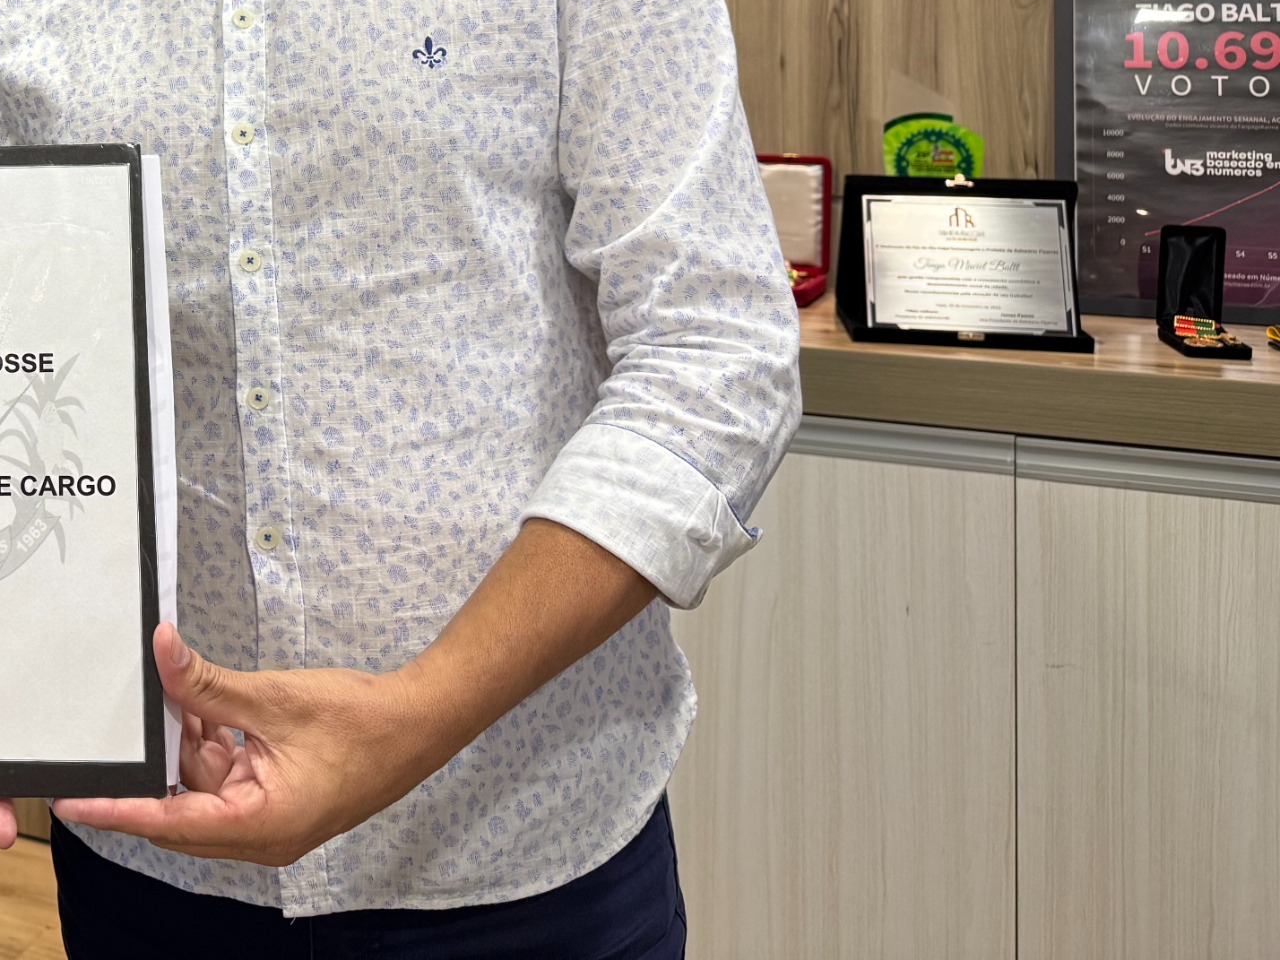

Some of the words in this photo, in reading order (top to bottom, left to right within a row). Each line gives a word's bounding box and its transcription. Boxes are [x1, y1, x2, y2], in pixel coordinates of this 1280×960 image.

[1134, 74, 1270, 97] VOTO
[1127, 113, 1165, 123] EVOLUÇÃO
[1178, 115, 1232, 123] ENGAJAMENTO
[1233, 116, 1270, 124] SEMANAL,
[1103, 128, 1124, 137] 10000
[1106, 150, 1125, 159] 8000
[1206, 150, 1272, 162] marketing
[1206, 159, 1263, 169] baseado
[1106, 172, 1125, 180] 6000
[1107, 193, 1125, 202] 4000
[1107, 215, 1125, 224] 2000
[1235, 249, 1245, 258] S4
[20, 475, 116, 497] CARGO
[16, 517, 48, 554] 1963
